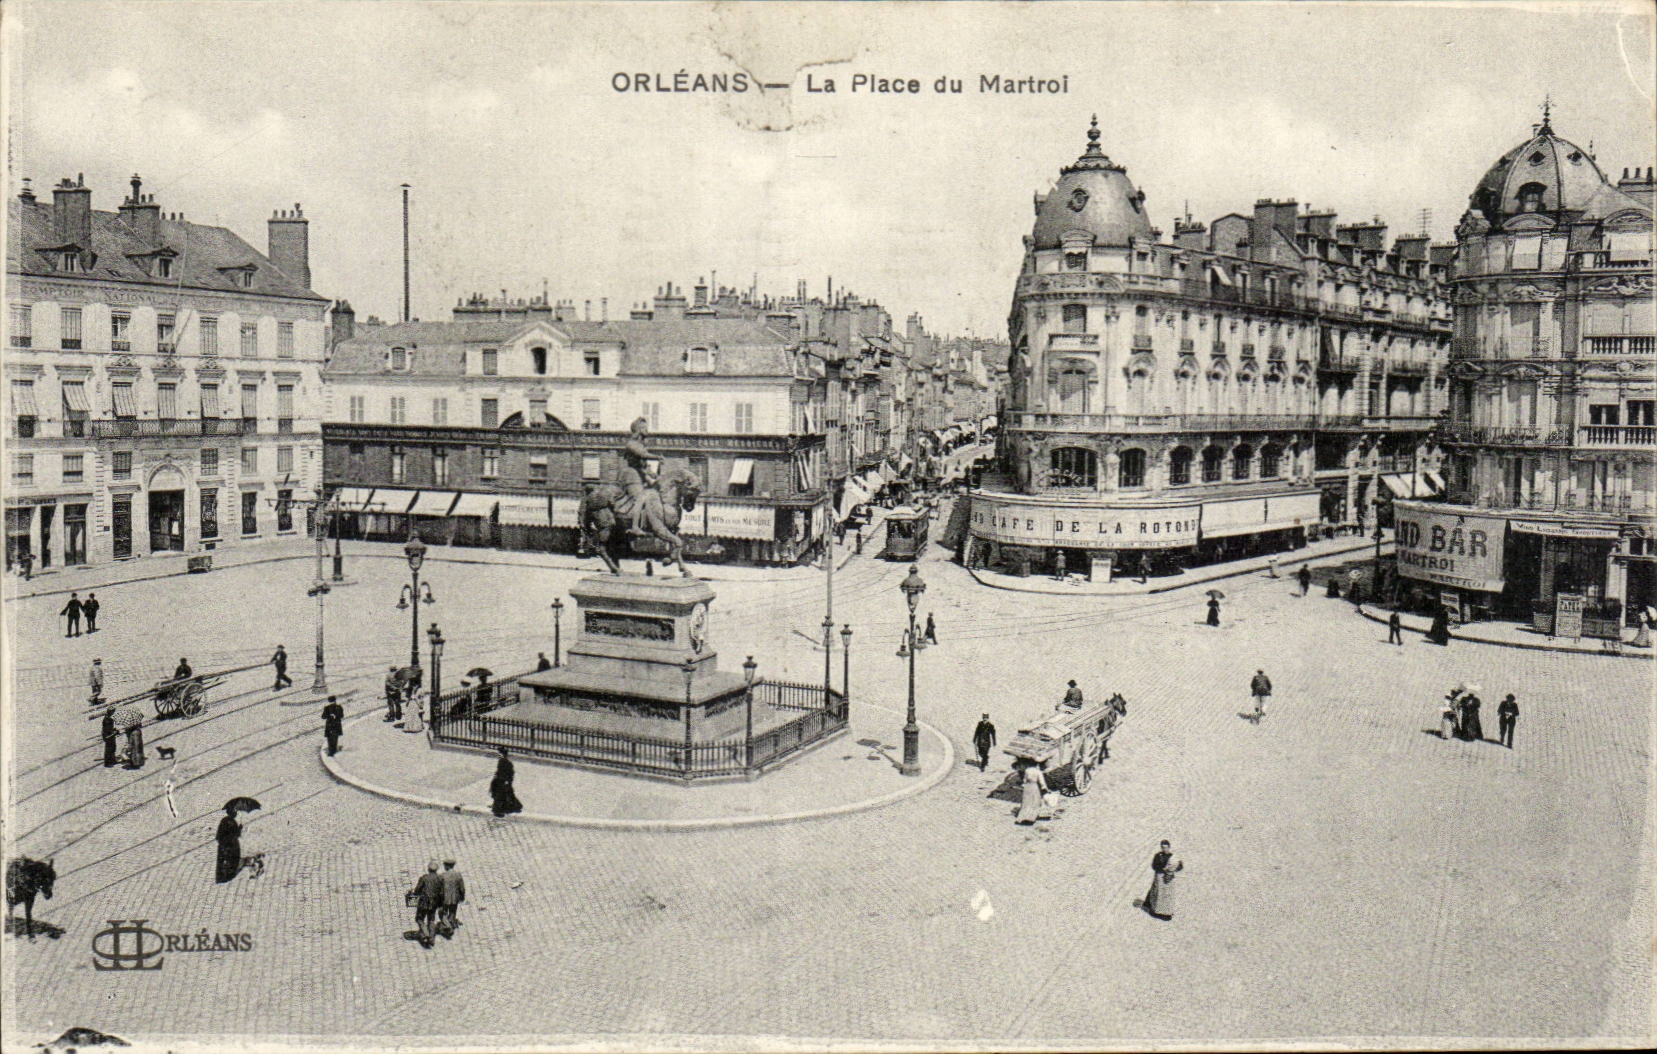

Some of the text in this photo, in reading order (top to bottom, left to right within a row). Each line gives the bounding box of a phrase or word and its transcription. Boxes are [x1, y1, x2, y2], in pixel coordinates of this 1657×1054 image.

[1055, 520, 1081, 532] DE
[1098, 521, 1123, 534] LA
[1430, 524, 1488, 558] BAR
